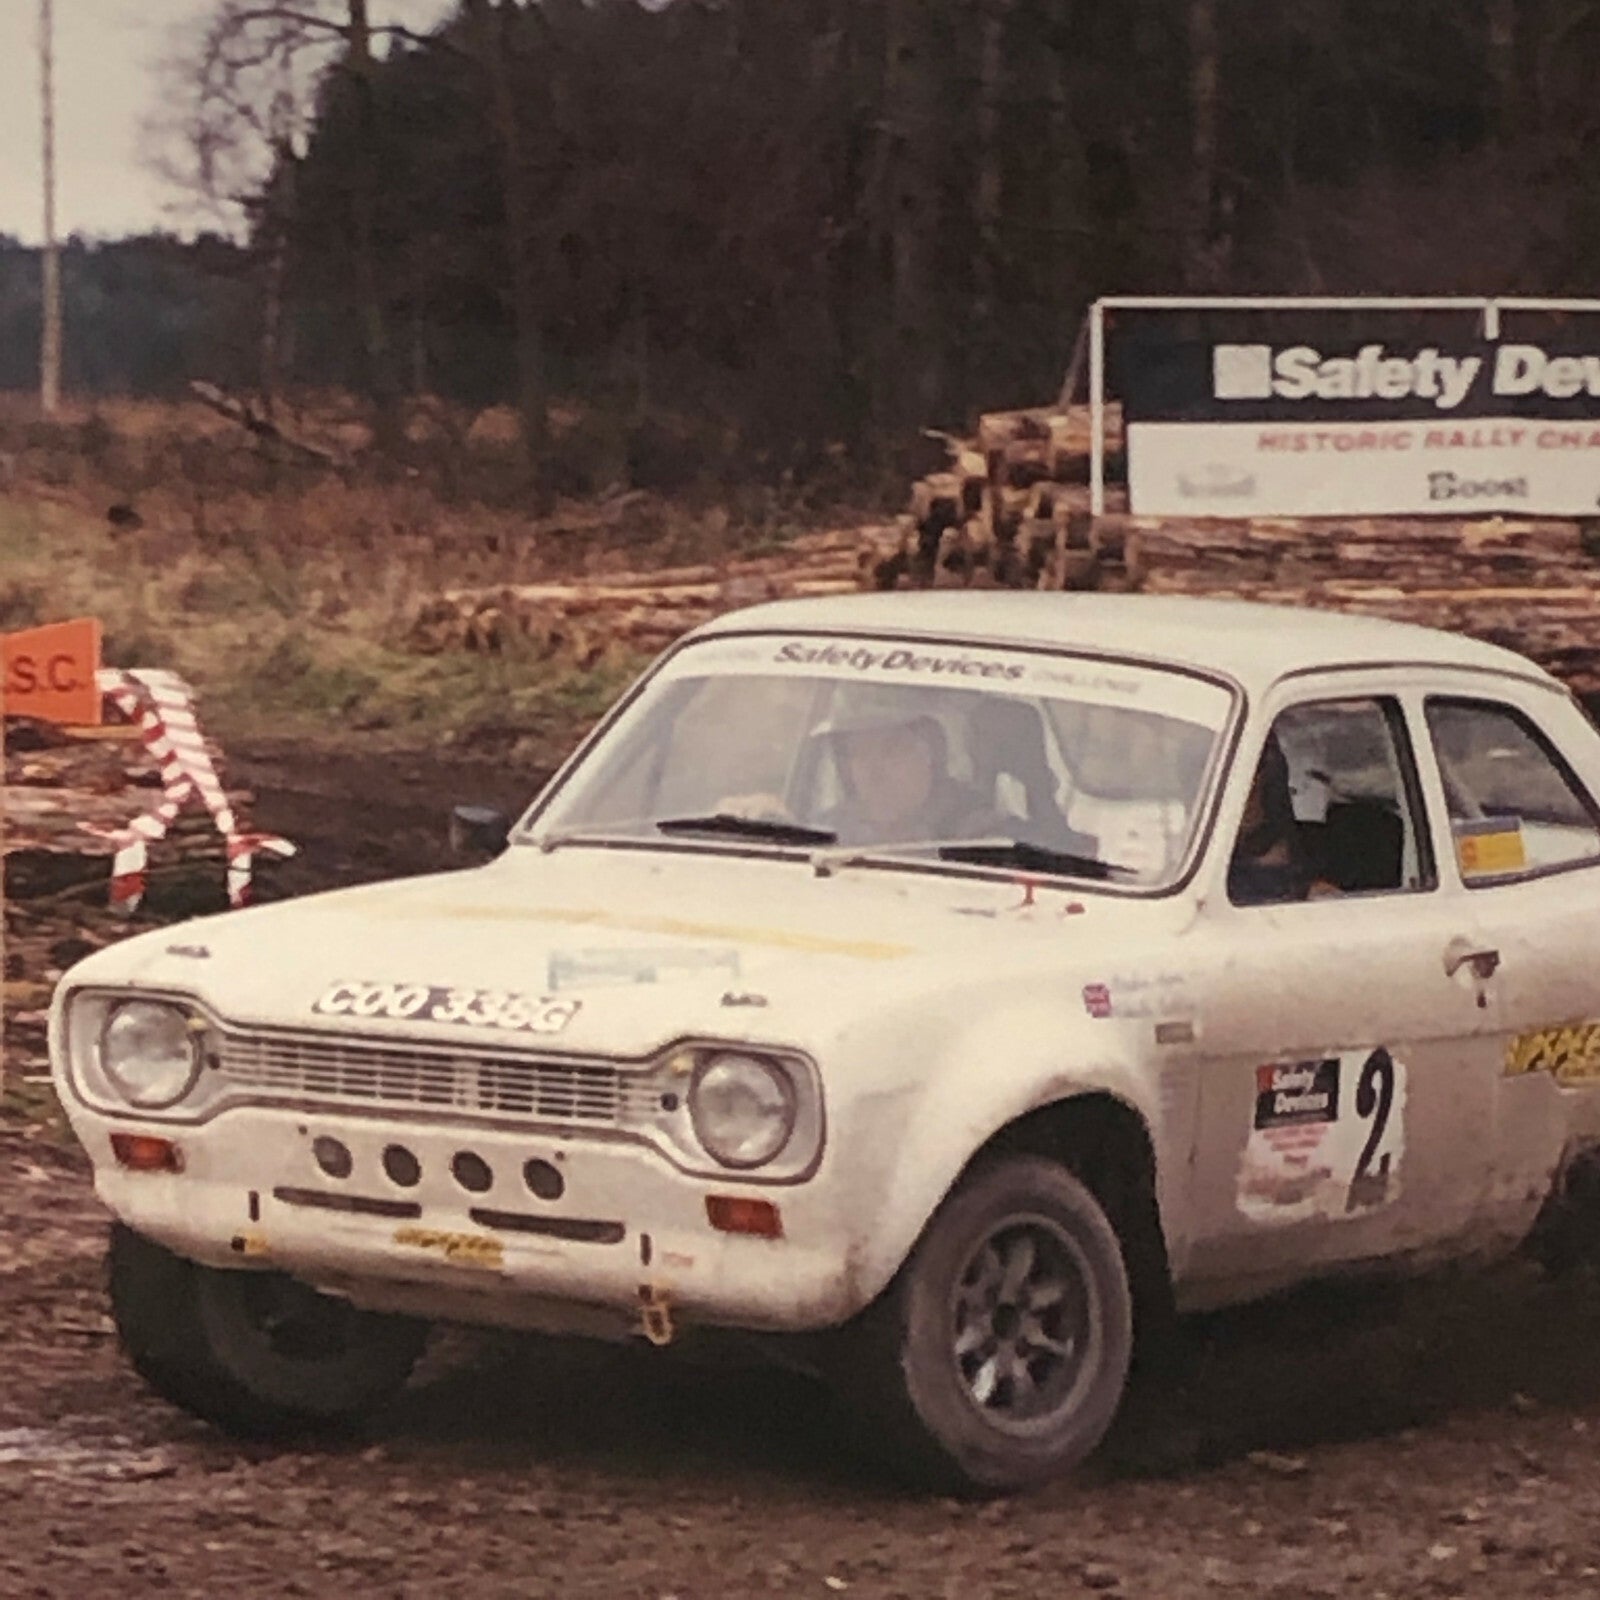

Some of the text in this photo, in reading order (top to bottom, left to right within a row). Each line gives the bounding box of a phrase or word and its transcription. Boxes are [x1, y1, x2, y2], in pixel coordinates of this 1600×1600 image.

[1272, 344, 1482, 409] Safety
[1256, 429, 1412, 452] HISTORIC
[1424, 428, 1526, 449] RALLY
[318, 982, 430, 1018] COO
[1345, 1046, 1394, 1213] 2
